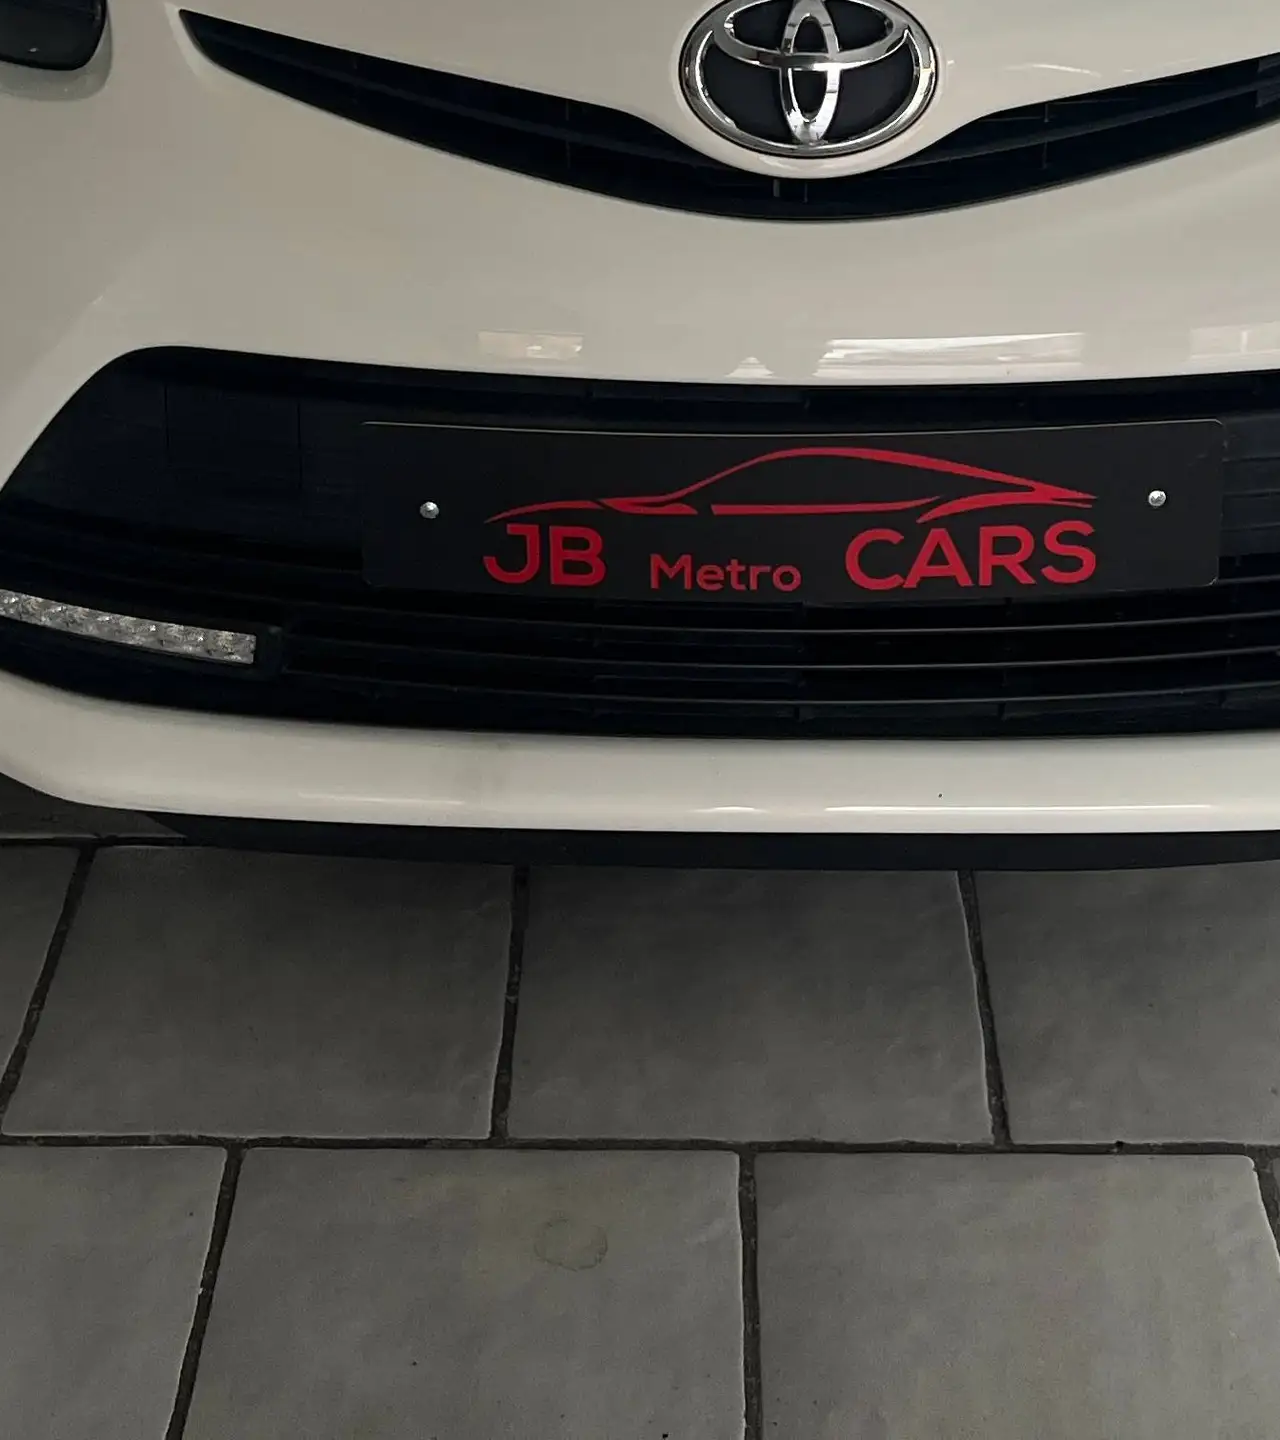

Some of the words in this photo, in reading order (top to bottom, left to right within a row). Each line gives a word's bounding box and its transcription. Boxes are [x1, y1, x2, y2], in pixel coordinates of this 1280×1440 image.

[482, 523, 607, 587] JB
[650, 554, 802, 592] Metro
[845, 520, 1097, 590] CARS
